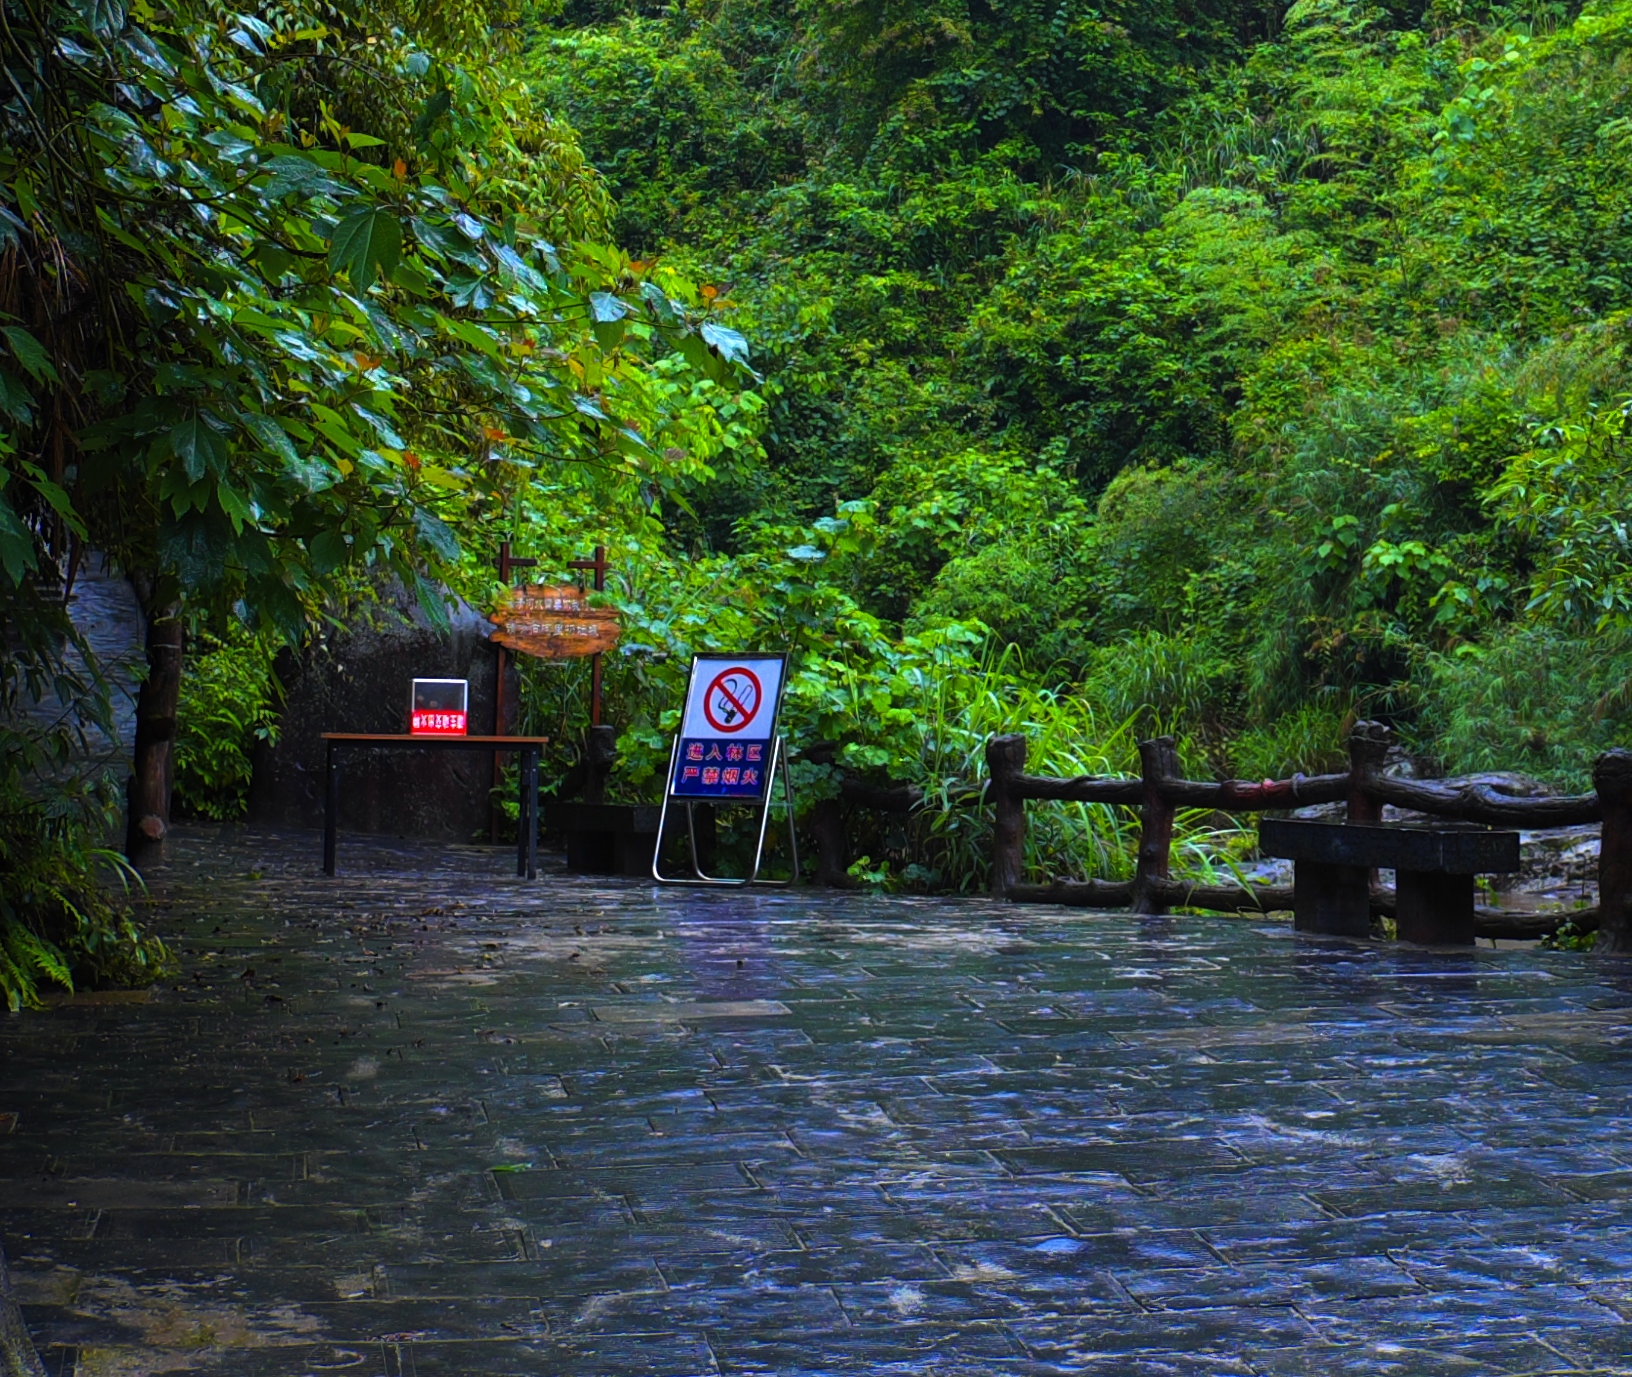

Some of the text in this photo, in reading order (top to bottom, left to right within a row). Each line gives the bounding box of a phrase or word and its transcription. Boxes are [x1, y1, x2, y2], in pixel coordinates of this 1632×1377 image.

[686, 743, 762, 761] 进入林区
[681, 766, 758, 785] 严禁烟火
